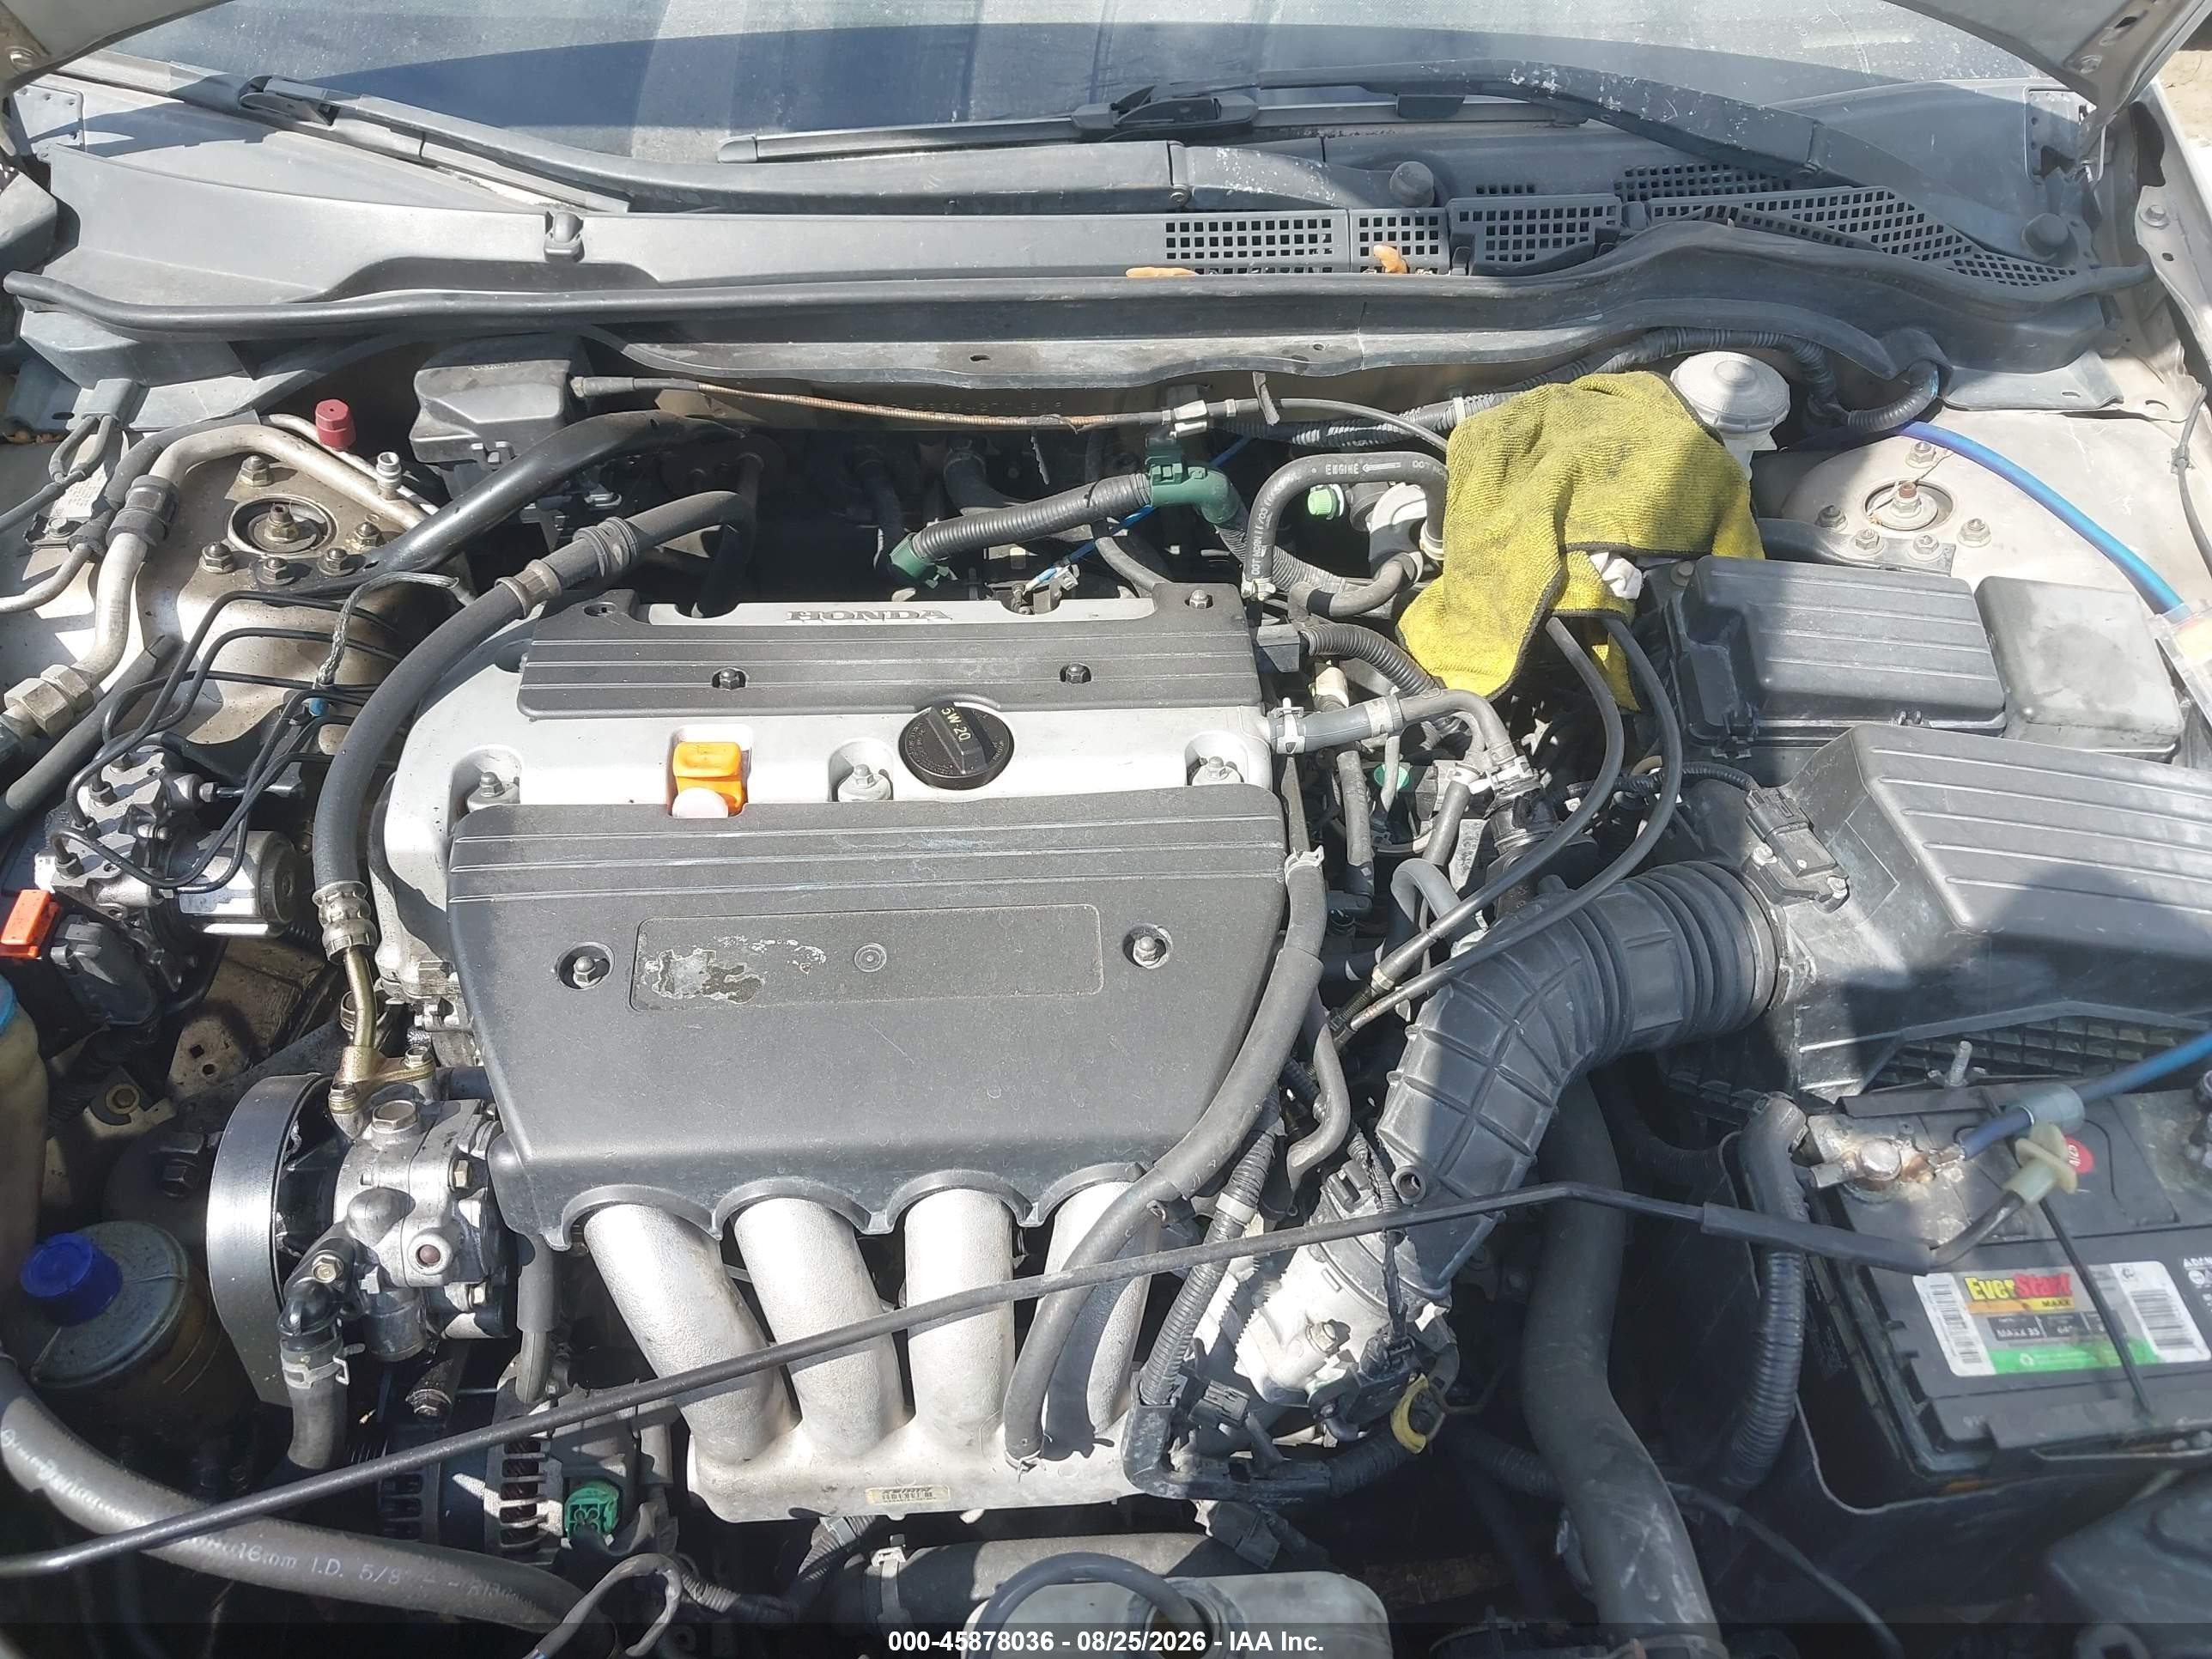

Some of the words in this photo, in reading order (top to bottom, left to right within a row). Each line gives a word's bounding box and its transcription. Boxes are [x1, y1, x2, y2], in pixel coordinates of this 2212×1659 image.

[1325, 463, 1359, 475] ENGINE
[786, 610, 953, 622] HONDA
[941, 707, 971, 742] 5W-20
[1964, 1273, 2072, 1301] EverStart
